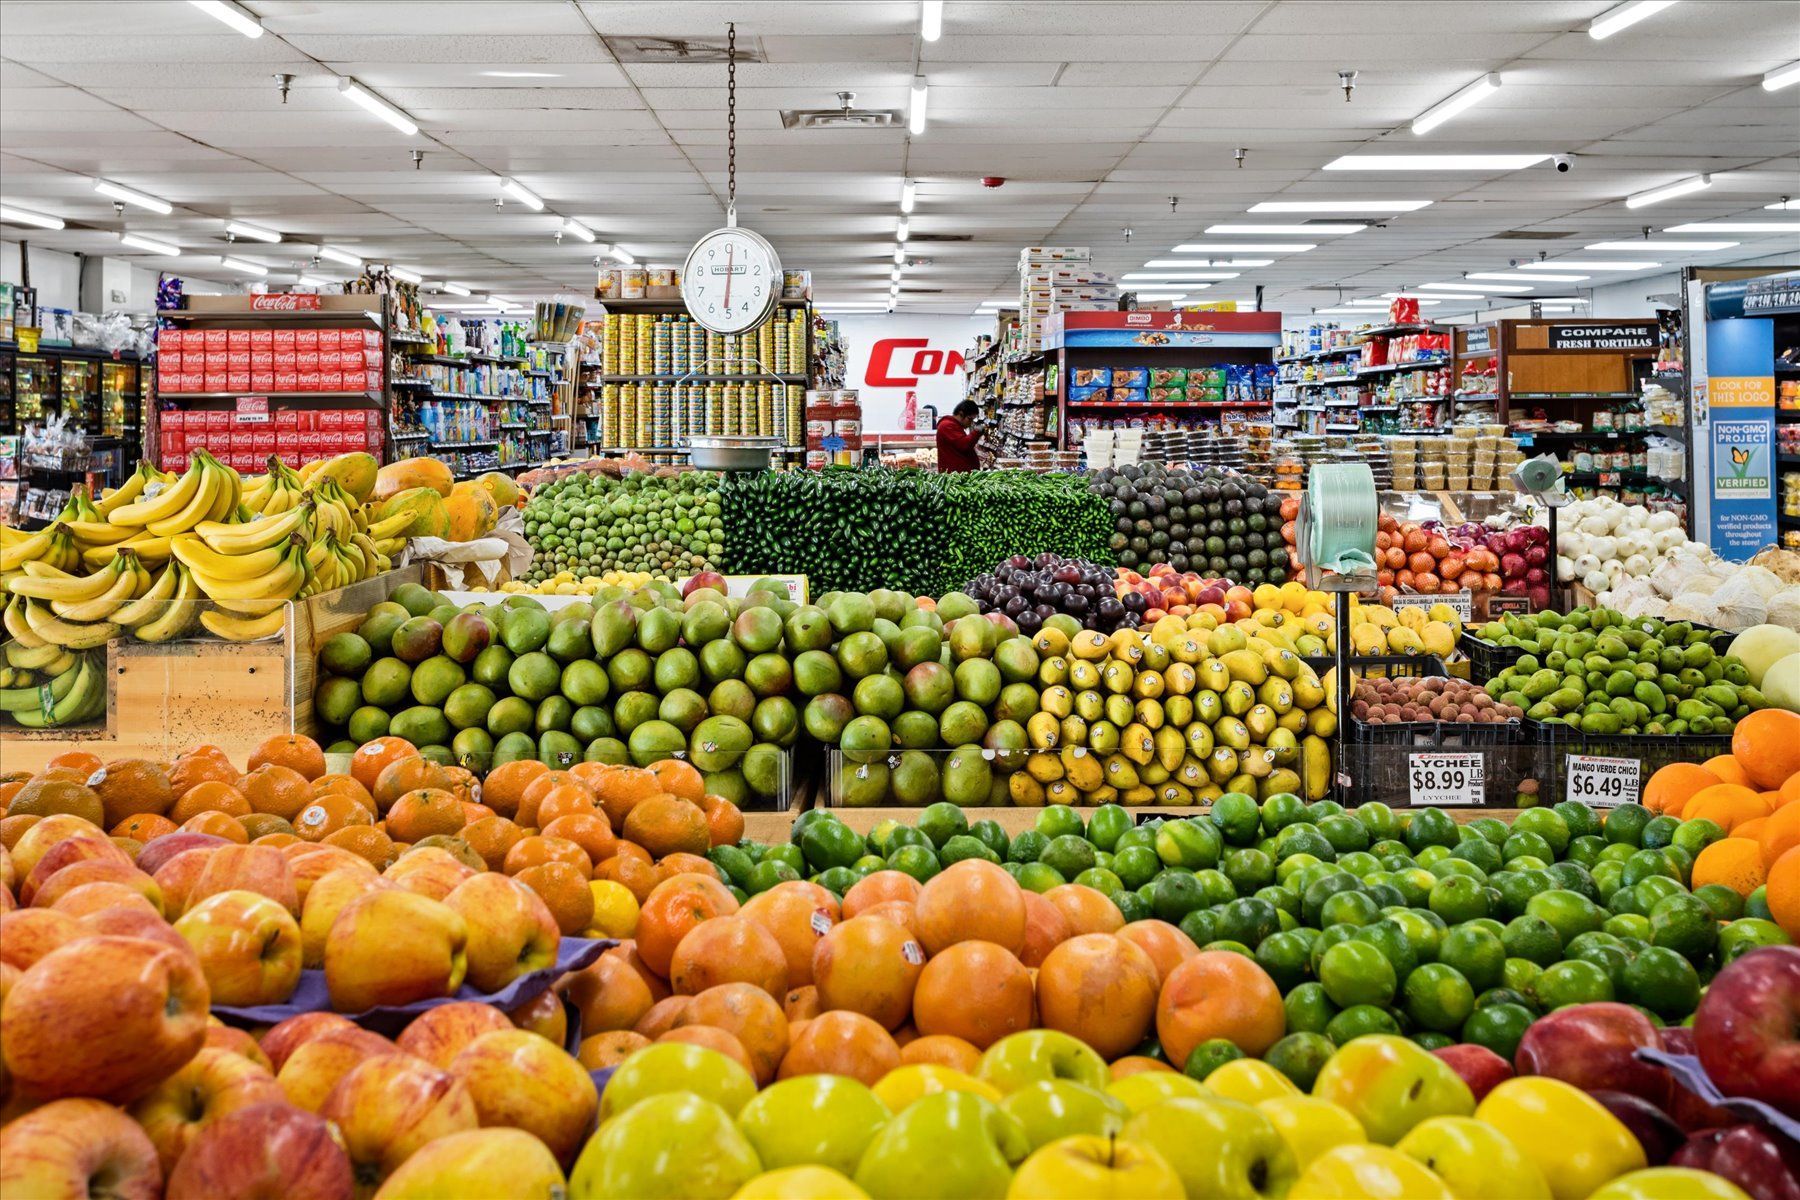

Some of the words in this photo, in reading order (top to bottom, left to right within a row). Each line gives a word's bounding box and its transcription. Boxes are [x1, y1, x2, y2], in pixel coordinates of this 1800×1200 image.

[708, 250, 715, 260] 9
[744, 249, 747, 259] 1
[697, 266, 703, 276] 8
[754, 265, 760, 276] 2
[698, 287, 704, 297] 7
[754, 286, 760, 296] 3
[708, 303, 715, 313] 6
[742, 302, 749, 312] 4
[725, 309, 732, 319] 5
[1561, 328, 1647, 336] COMPARE
[1557, 340, 1591, 348] FRESH
[1594, 338, 1652, 348] TORTILLAS
[1717, 382, 1741, 390] LOOK
[1745, 381, 1762, 390] FOR
[1712, 392, 1734, 402] THIS
[1739, 391, 1770, 402] LOGO
[1718, 425, 1766, 433] NON-GMO
[1719, 479, 1766, 487] VERIFIED
[1470, 769, 1483, 778] LB
[1573, 763, 1595, 772] MANGO
[1597, 765, 1616, 773] VERDE
[1618, 766, 1637, 775] CHICO
[1413, 769, 1464, 792] $8.99
[1573, 773, 1621, 796] $6.49
